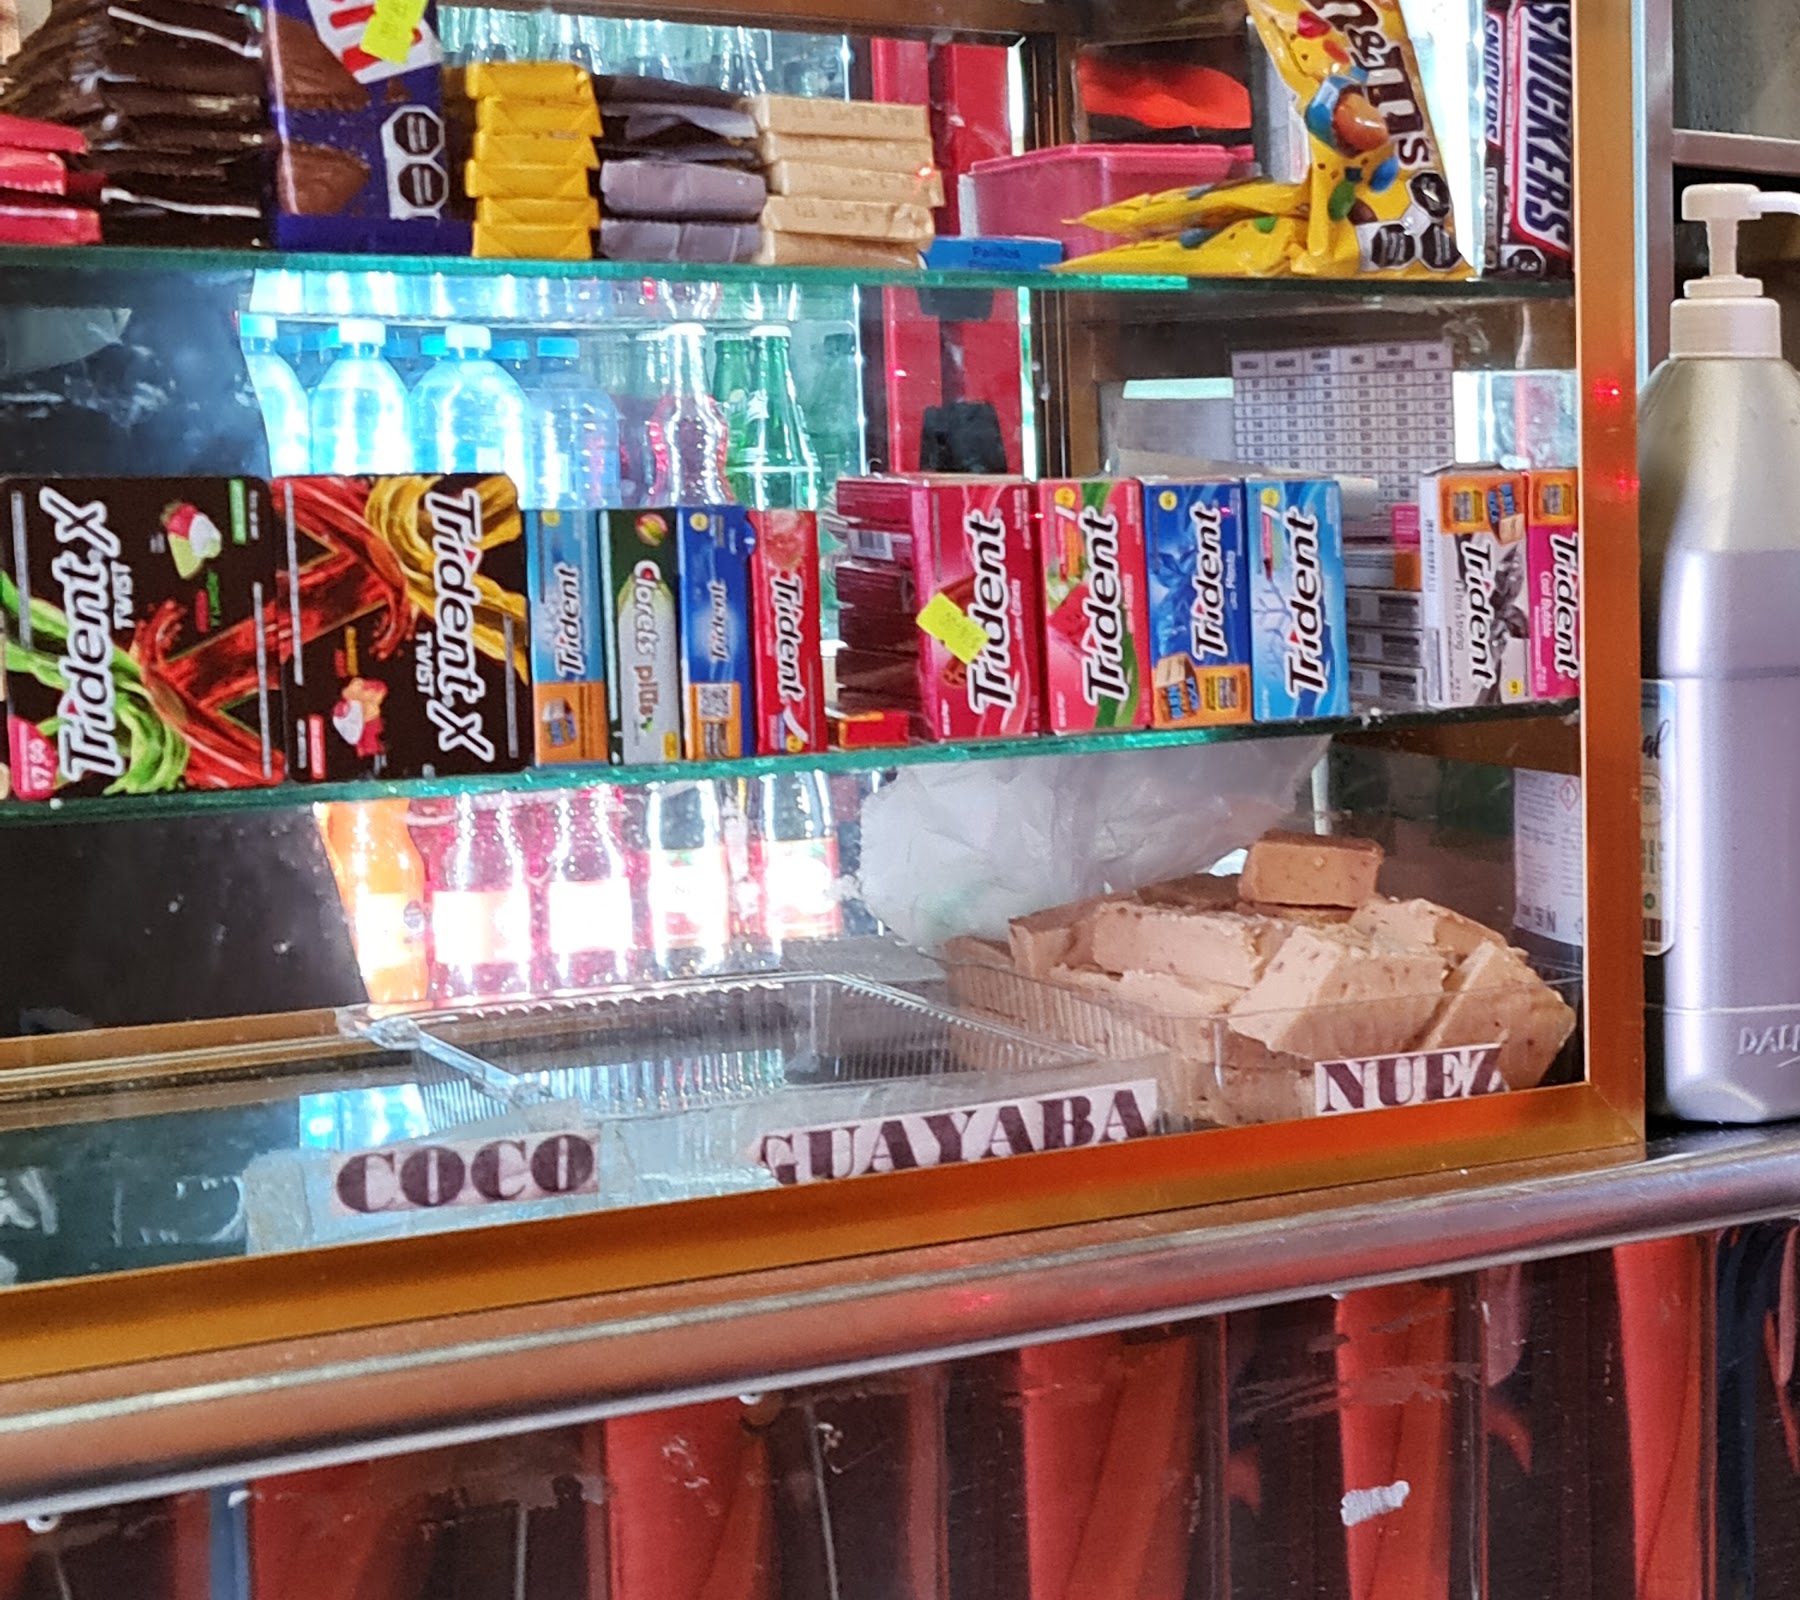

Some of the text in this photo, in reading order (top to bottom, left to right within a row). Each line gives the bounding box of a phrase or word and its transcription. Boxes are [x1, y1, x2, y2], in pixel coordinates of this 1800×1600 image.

[1524, 3, 1571, 247] SNICKERS
[112, 561, 136, 630] TWIST
[425, 489, 487, 703] Trident
[553, 562, 586, 678] Trident
[633, 559, 662, 656] Clorets
[707, 579, 730, 664] Trident
[771, 573, 806, 703] Trident
[965, 509, 1016, 714] Trident
[1078, 506, 1130, 706] Trident
[1189, 501, 1229, 660] Trident
[1283, 505, 1328, 699] Trident
[1461, 541, 1497, 688] Trident
[1550, 531, 1579, 679] Trident
[52, 551, 126, 782] Trident
[413, 630, 434, 698] TWIST
[760, 1088, 1150, 1185] GUAYABA
[1321, 1048, 1510, 1113] NUEZ
[335, 1133, 595, 1213] COCO
